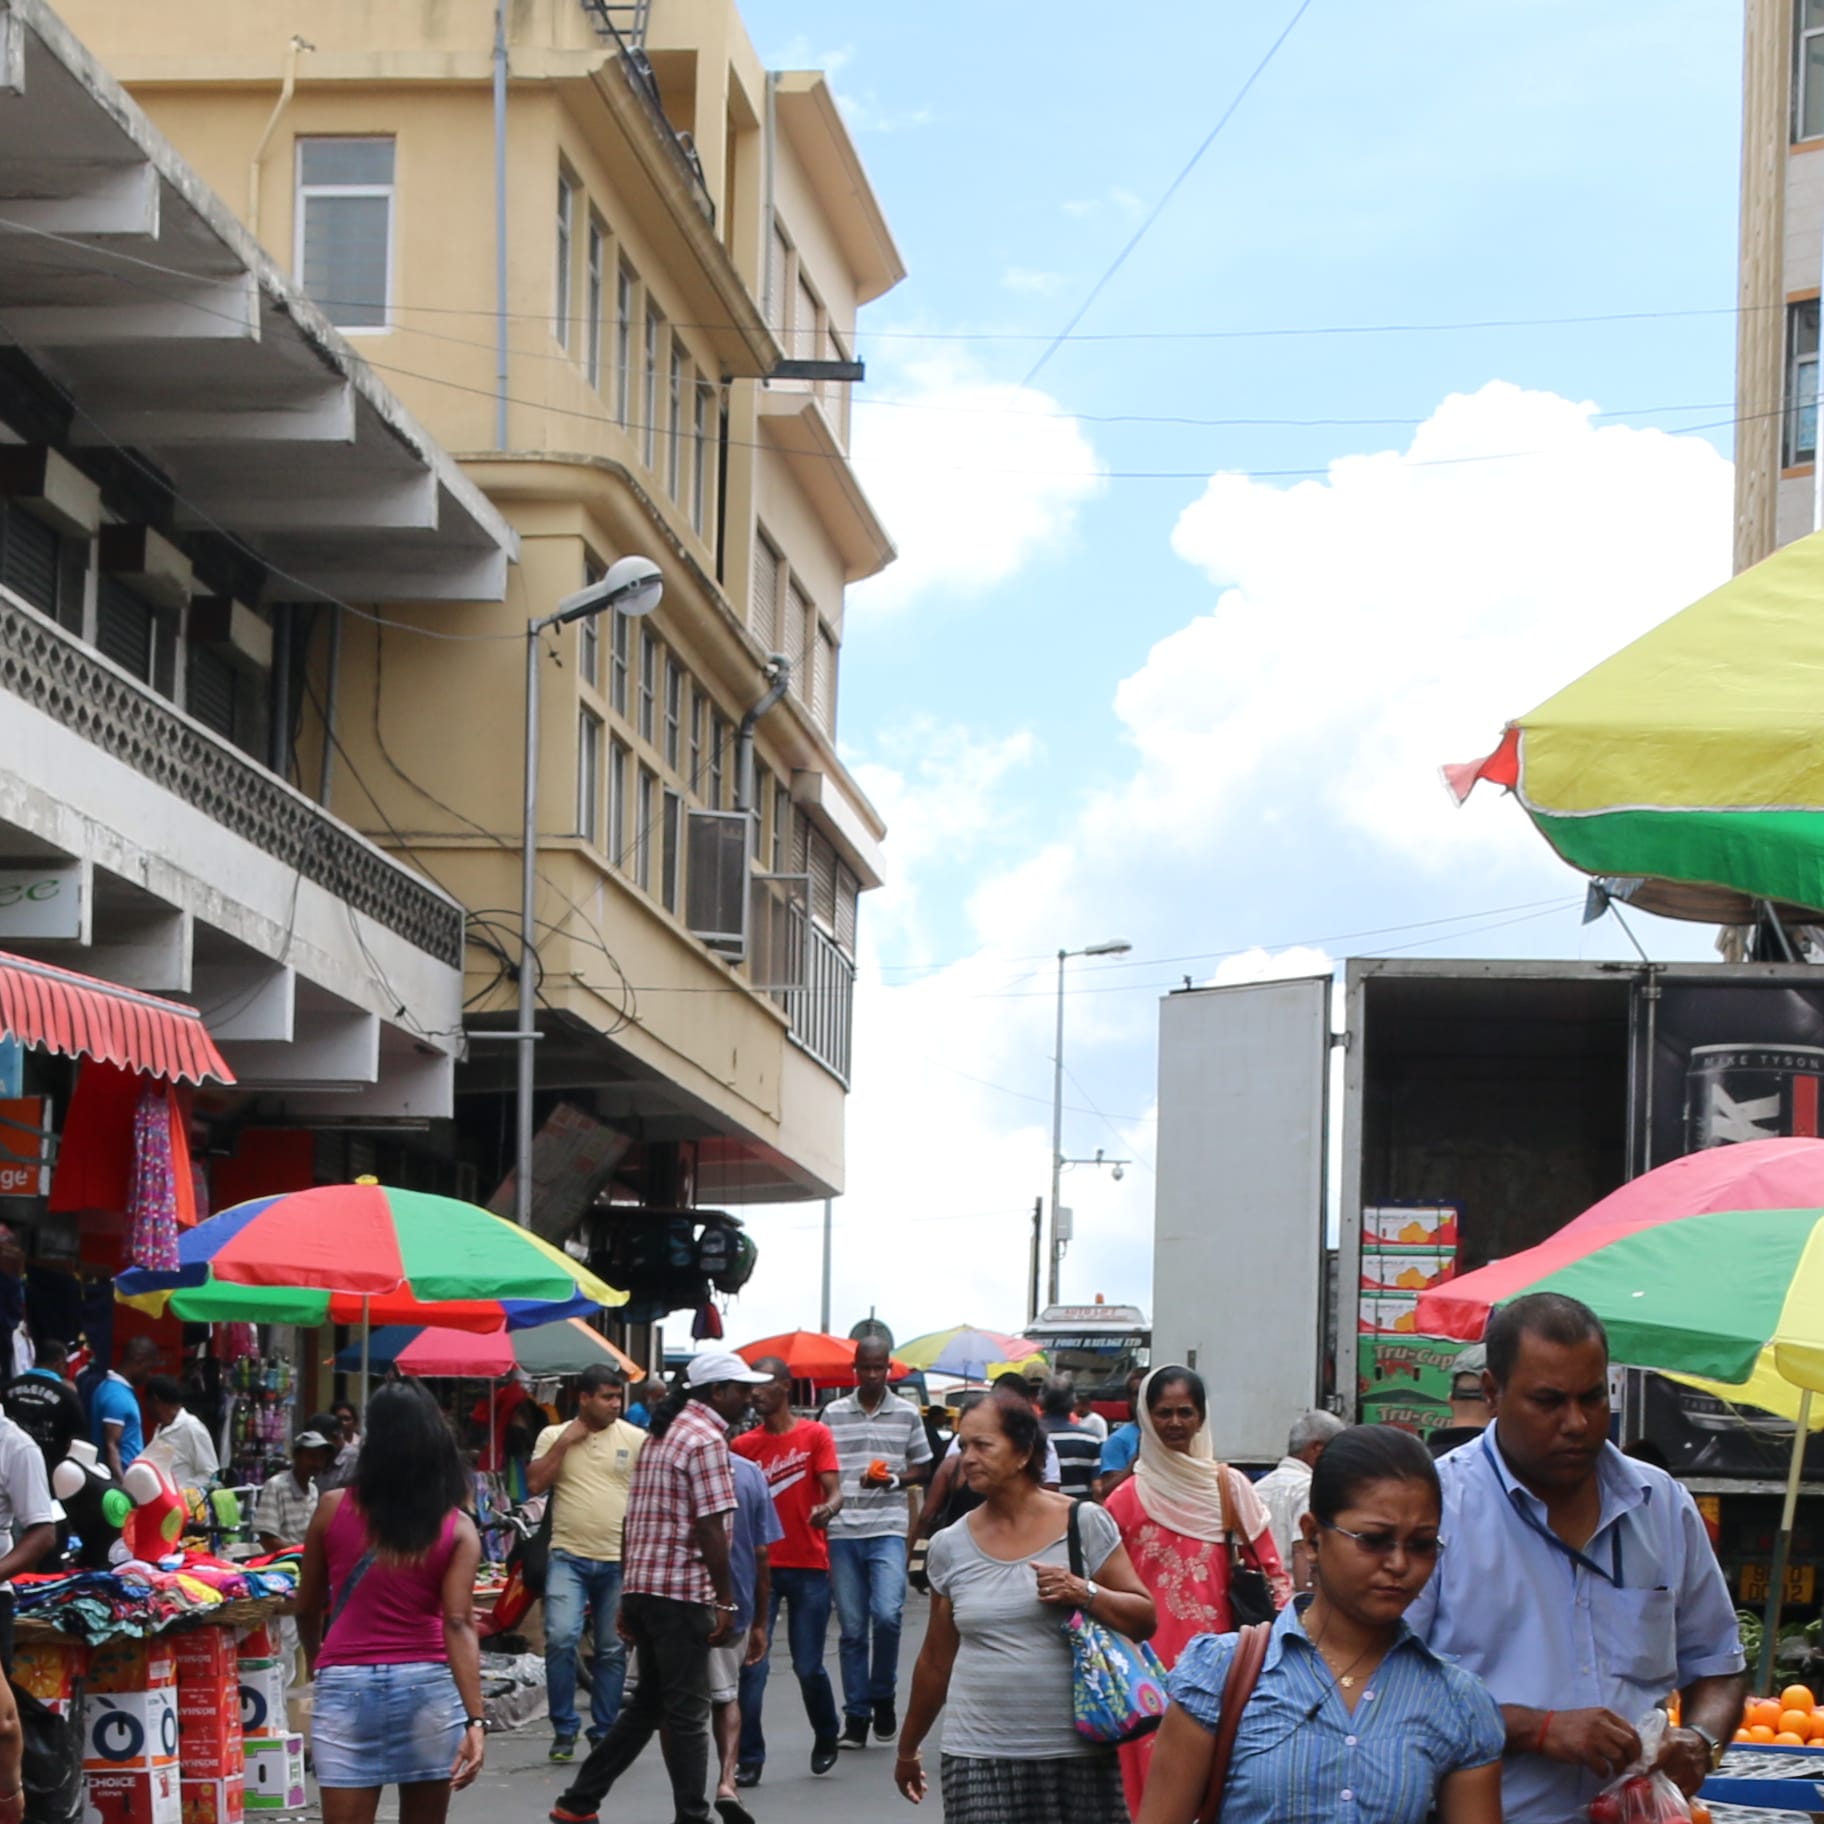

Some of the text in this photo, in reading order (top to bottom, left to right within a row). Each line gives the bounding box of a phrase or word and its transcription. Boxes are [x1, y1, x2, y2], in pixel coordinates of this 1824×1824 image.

[1703, 1055, 1820, 1069] MIKE TYSON
[87, 1775, 137, 1789] CHOICE
